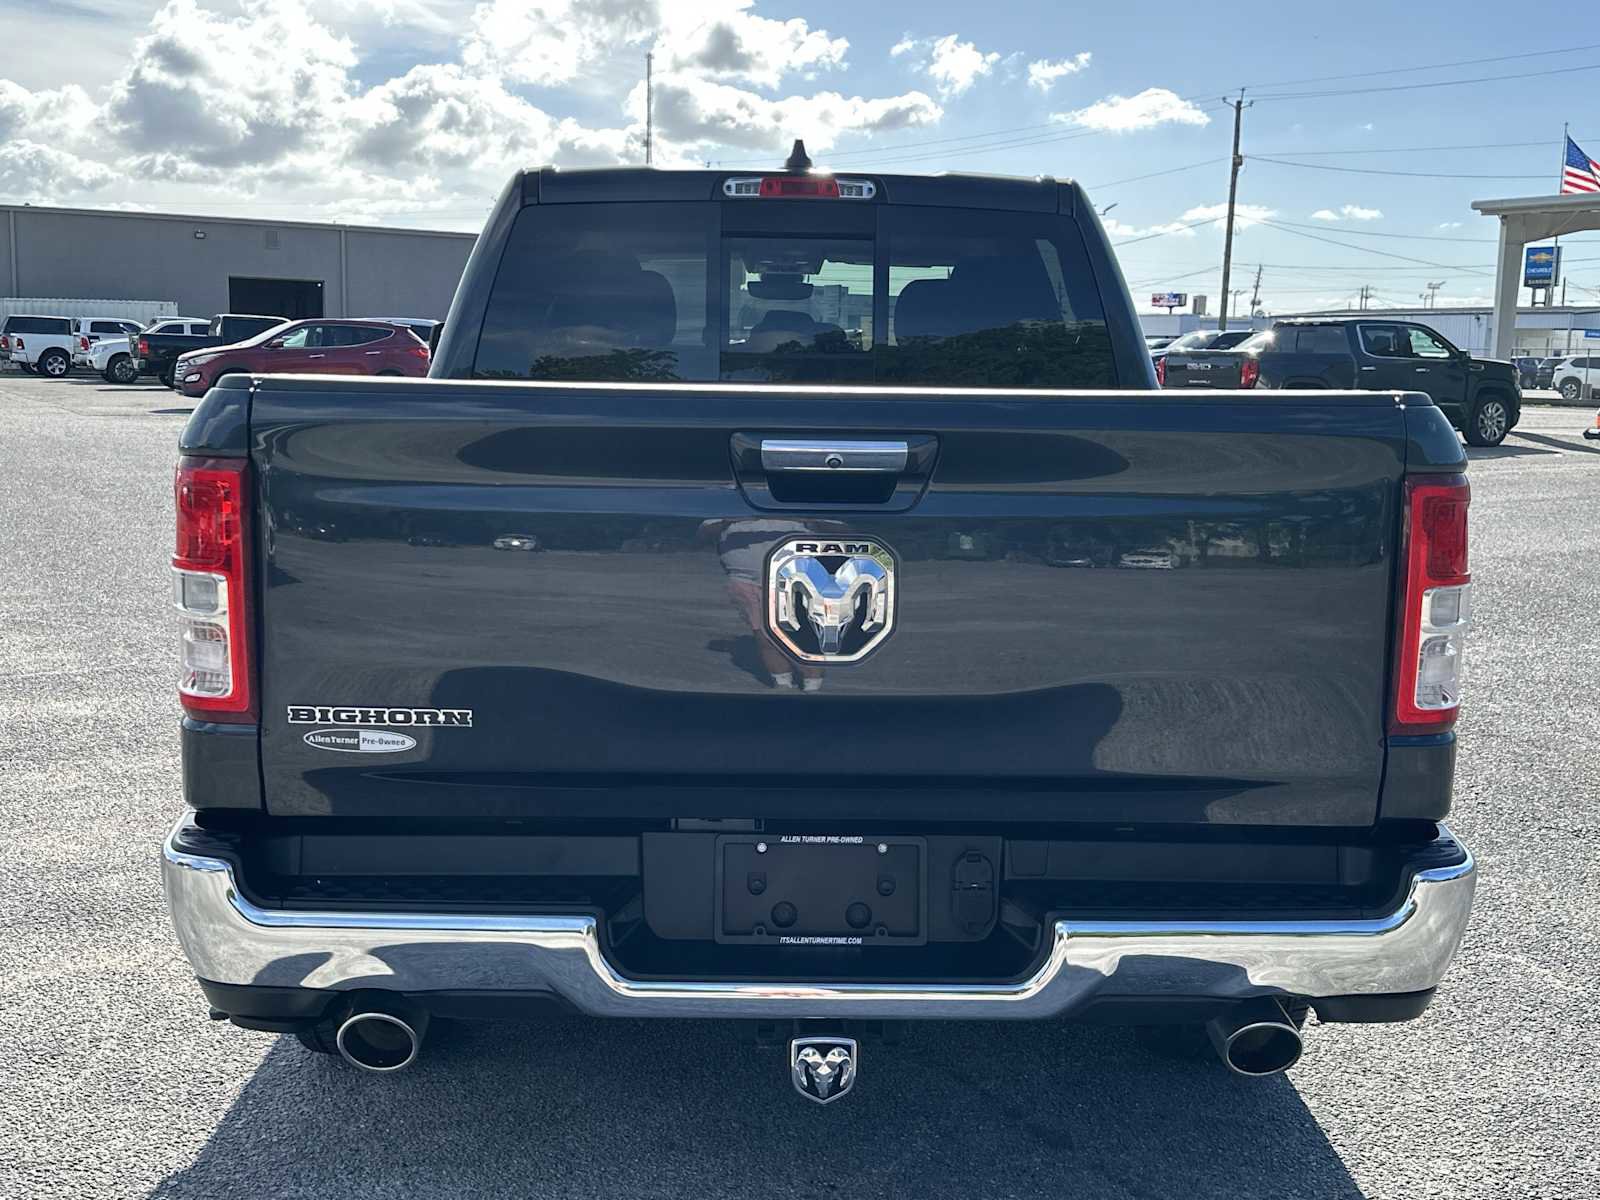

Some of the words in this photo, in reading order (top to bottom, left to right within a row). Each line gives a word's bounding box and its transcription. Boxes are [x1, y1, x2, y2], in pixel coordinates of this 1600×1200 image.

[795, 543, 870, 553] RAM
[287, 705, 473, 727] BIGHORN
[361, 737, 406, 746] Pre-Owned
